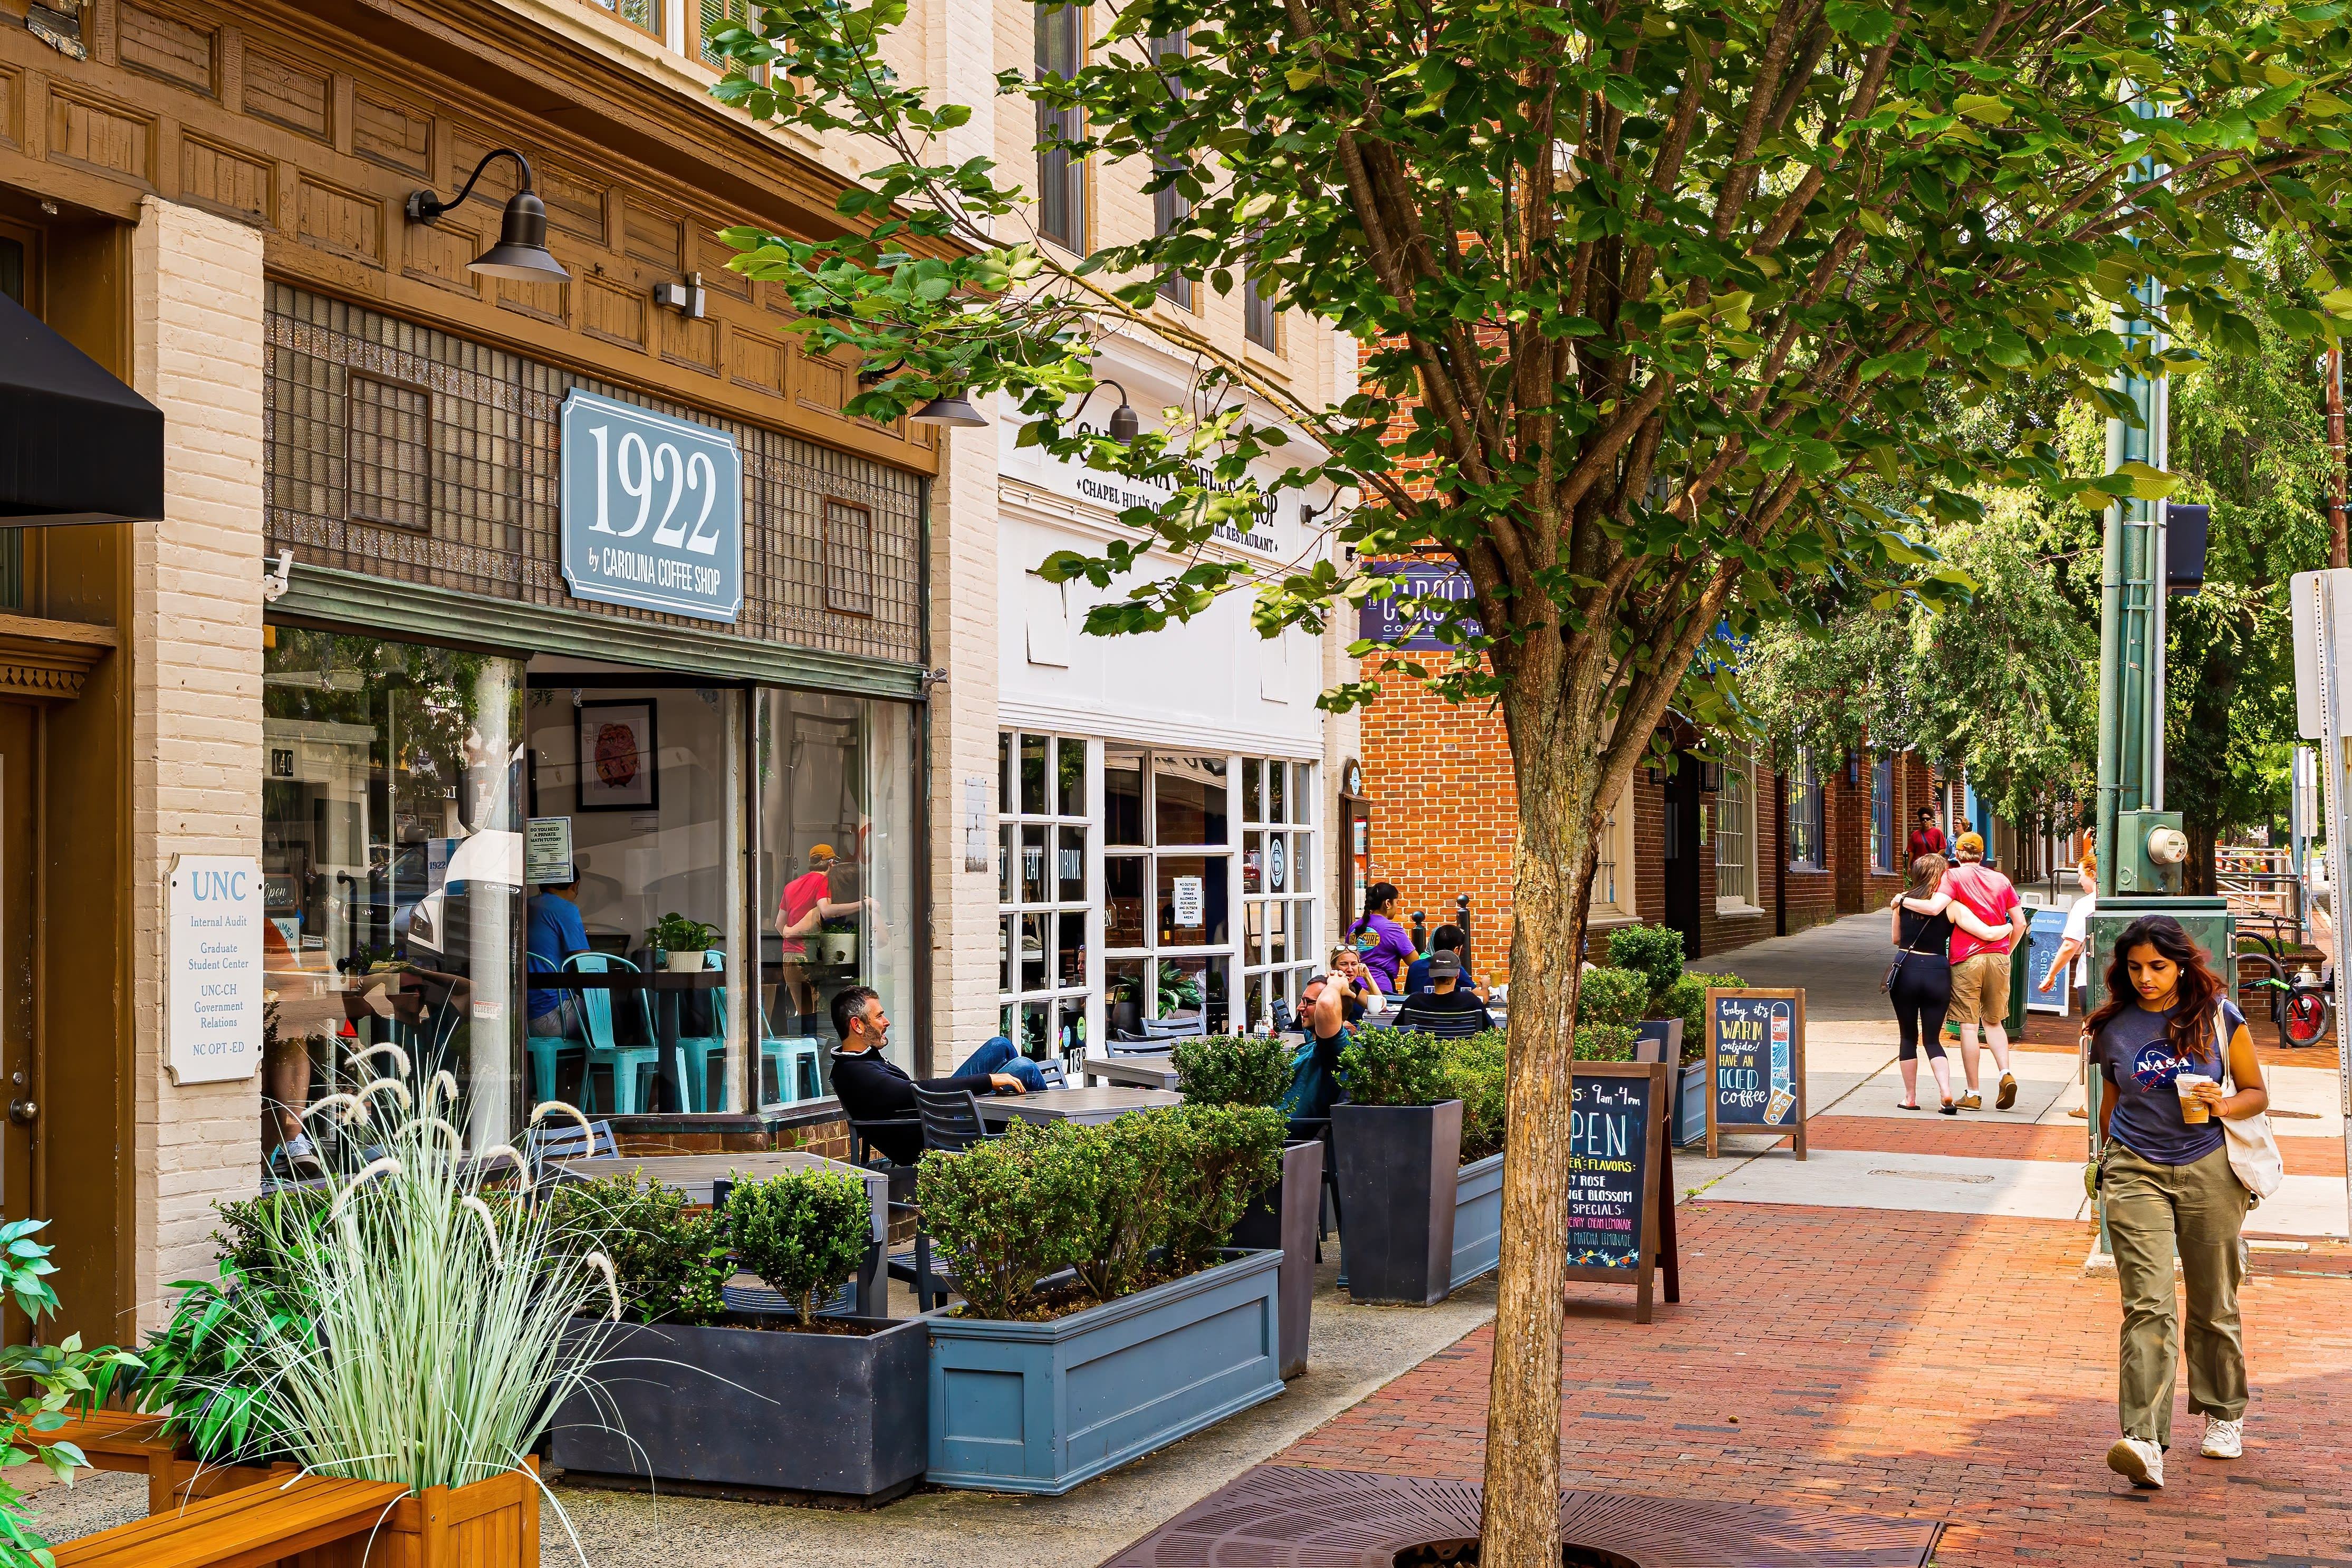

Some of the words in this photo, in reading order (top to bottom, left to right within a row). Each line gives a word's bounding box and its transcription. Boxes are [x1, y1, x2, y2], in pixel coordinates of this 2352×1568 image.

[588, 425, 719, 555] 1922
[1082, 479, 1119, 504] CHAPEL
[1226, 526, 1274, 553] RESTAURANT
[588, 546, 599, 572] by
[603, 547, 656, 584] CAROLINA
[658, 557, 693, 591] COFFEE
[694, 565, 721, 596] SHOP
[274, 753, 293, 773] 140
[429, 861, 446, 870] 1922
[1026, 849, 1039, 880] EAT
[1060, 849, 1081, 879] DRINK
[191, 871, 246, 901] UNC
[263, 882, 286, 901] Open
[190, 916, 222, 927] Internal
[225, 915, 247, 927] Audit
[200, 942, 237, 954] Graduate
[188, 958, 220, 970] Student
[223, 957, 248, 969] Center
[2040, 950, 2050, 983] Cente
[201, 983, 237, 996] UNC-CH
[194, 1001, 243, 1013] Government
[1721, 1001, 1749, 1021] baby
[1753, 1002, 1769, 1018] it's
[201, 1017, 237, 1028] Relations
[1719, 1019, 1763, 1041] WARM
[193, 1043, 206, 1056] NC
[208, 1042, 227, 1055] OPT
[1721, 1041, 1760, 1055] outside!
[1719, 1055, 1738, 1067] HAVE
[1742, 1055, 1753, 1067] AN
[2137, 1057, 2192, 1072] NASA
[1720, 1069, 1759, 1091] ICED
[1721, 1089, 1768, 1108] coffee
[1570, 1110, 1626, 1157] PEN
[1588, 1159, 1636, 1172] FLAVORS:
[1580, 1175, 1606, 1187] ROSE
[1588, 1189, 1632, 1203] BLOSSOM
[1572, 1204, 1625, 1215] SPECIALS:
[1588, 1218, 1605, 1229] CREAM
[1605, 1218, 1632, 1230] LEMONADE
[1574, 1232, 1598, 1245] MATCHA
[1601, 1233, 1631, 1247] LEMONADE
